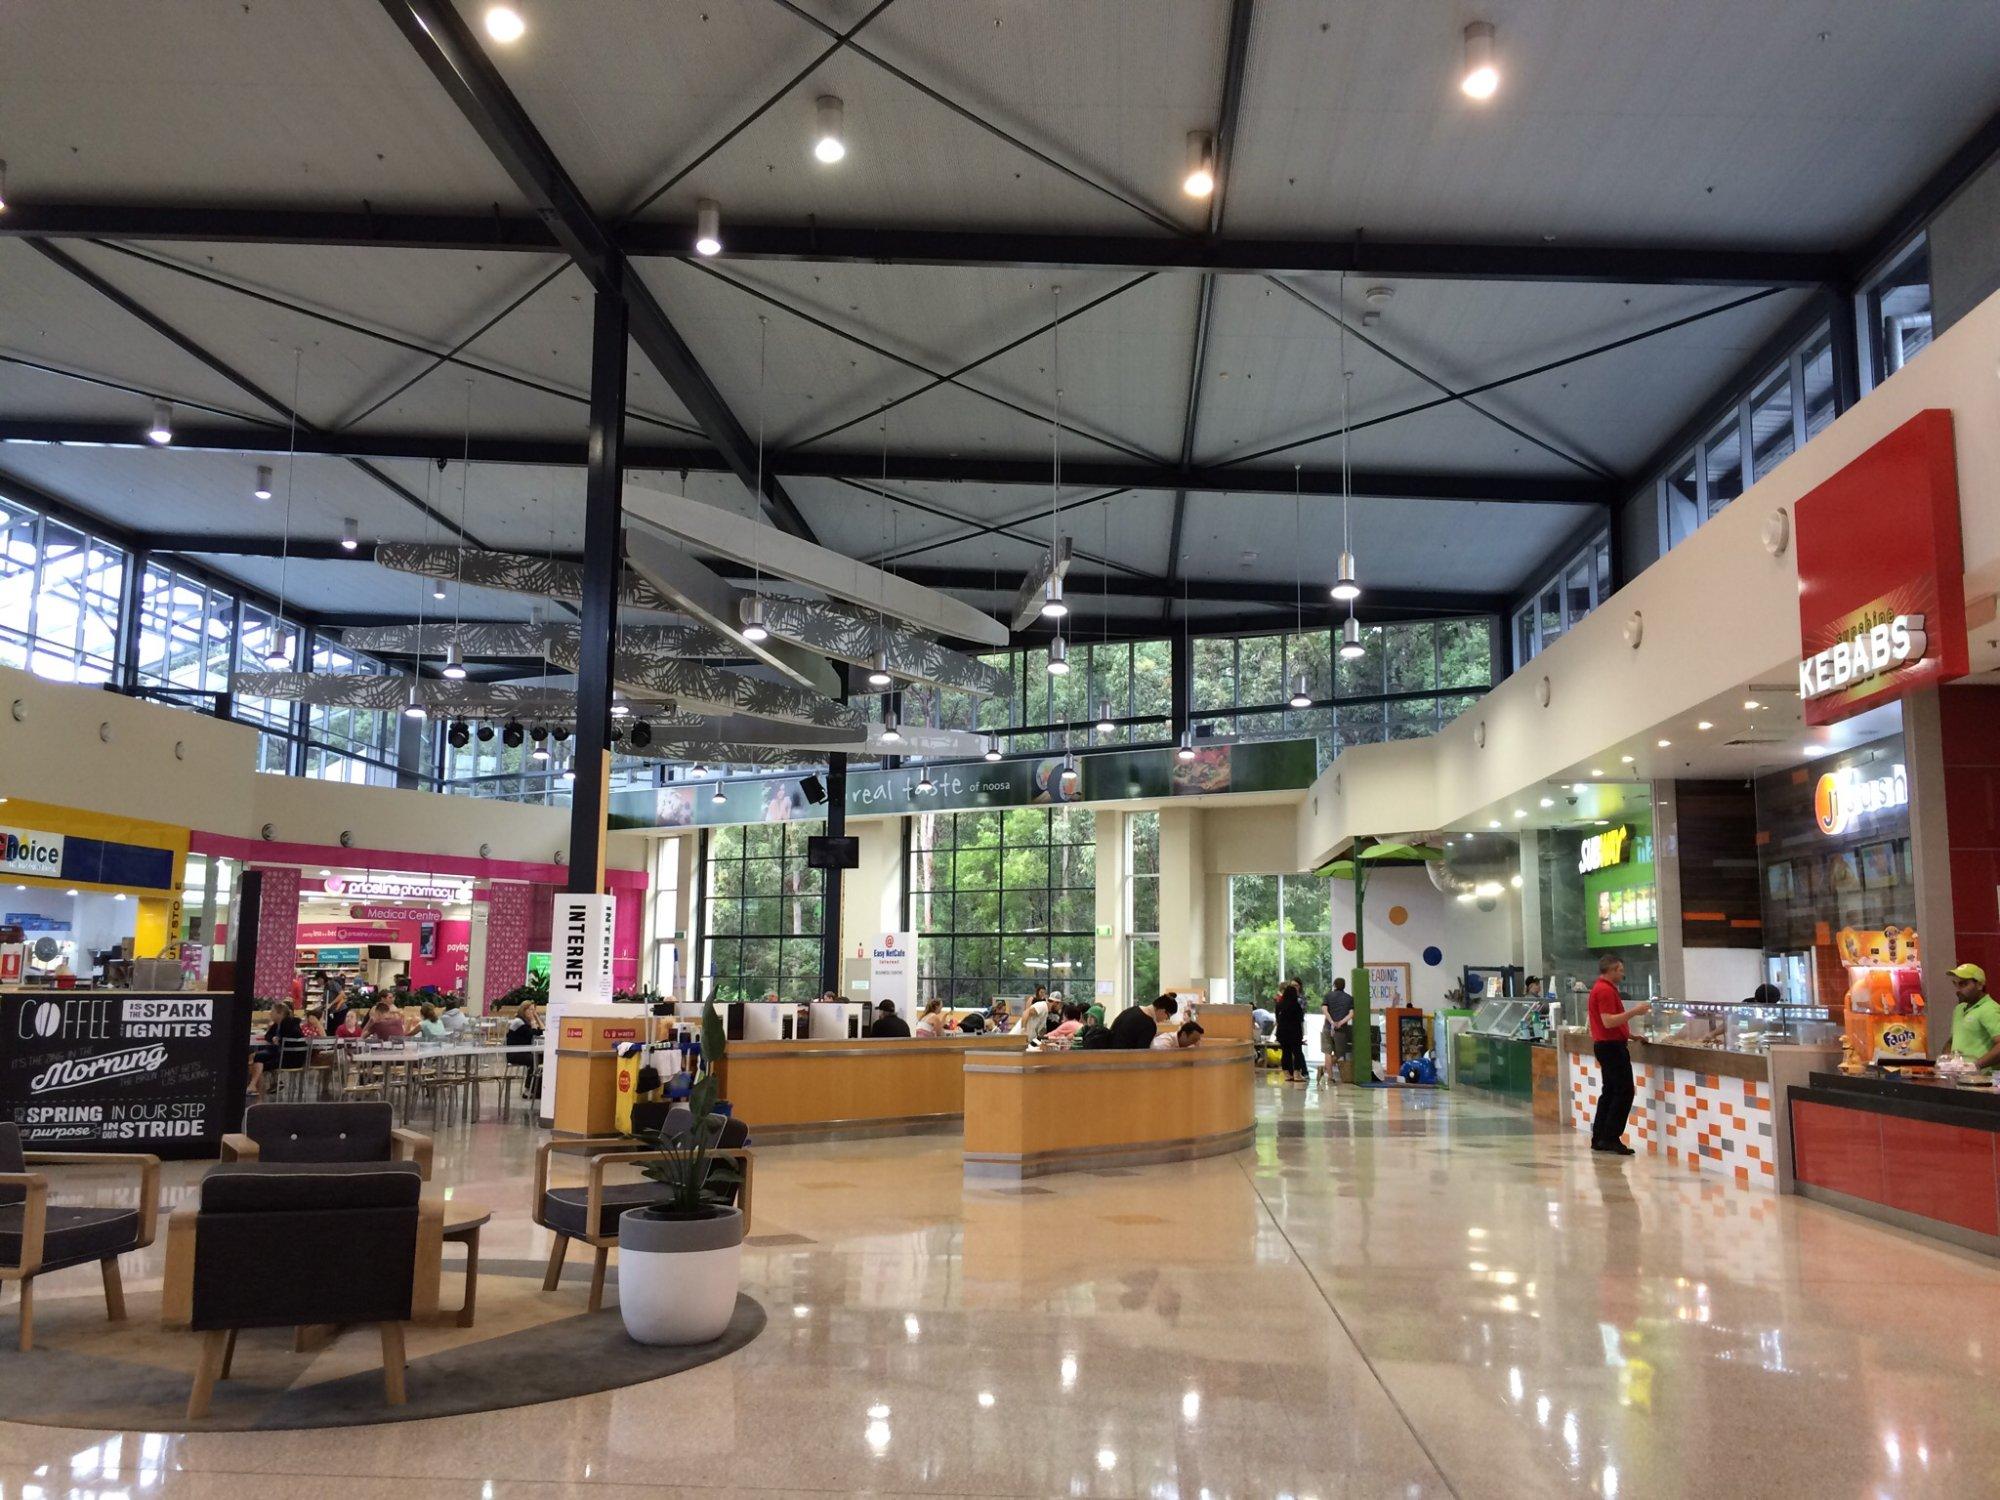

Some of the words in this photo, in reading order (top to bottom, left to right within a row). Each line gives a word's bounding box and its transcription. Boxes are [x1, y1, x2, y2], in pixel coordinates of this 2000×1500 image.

[1799, 614, 1911, 700] KEBABS
[852, 780, 892, 804] real
[903, 773, 963, 799] taste
[969, 782, 979, 792] of
[983, 781, 1011, 791] noosa
[349, 879, 401, 896] priceline
[401, 884, 454, 901] pharmacy
[367, 908, 407, 919] Medical
[408, 910, 441, 921] Centre
[447, 942, 469, 953] paying
[565, 904, 587, 992] INTERNET
[873, 949, 885, 958] Easy
[1371, 969, 1398, 982] EADING
[129, 1010, 141, 1018] THE
[143, 1002, 208, 1018] SPARK
[19, 1000, 113, 1040] COFFEE
[125, 1023, 212, 1038] IGNITES
[1883, 1030, 1915, 1049] Fanta
[31, 1046, 169, 1090] Morning
[27, 1106, 103, 1123] SPRING
[111, 1105, 125, 1119] IN
[130, 1104, 166, 1119] OUR
[171, 1102, 206, 1118] STEP
[30, 1125, 91, 1142] purpose
[102, 1122, 119, 1131] IN
[119, 1120, 205, 1138] STRIDE
[102, 1131, 118, 1139] OUR
